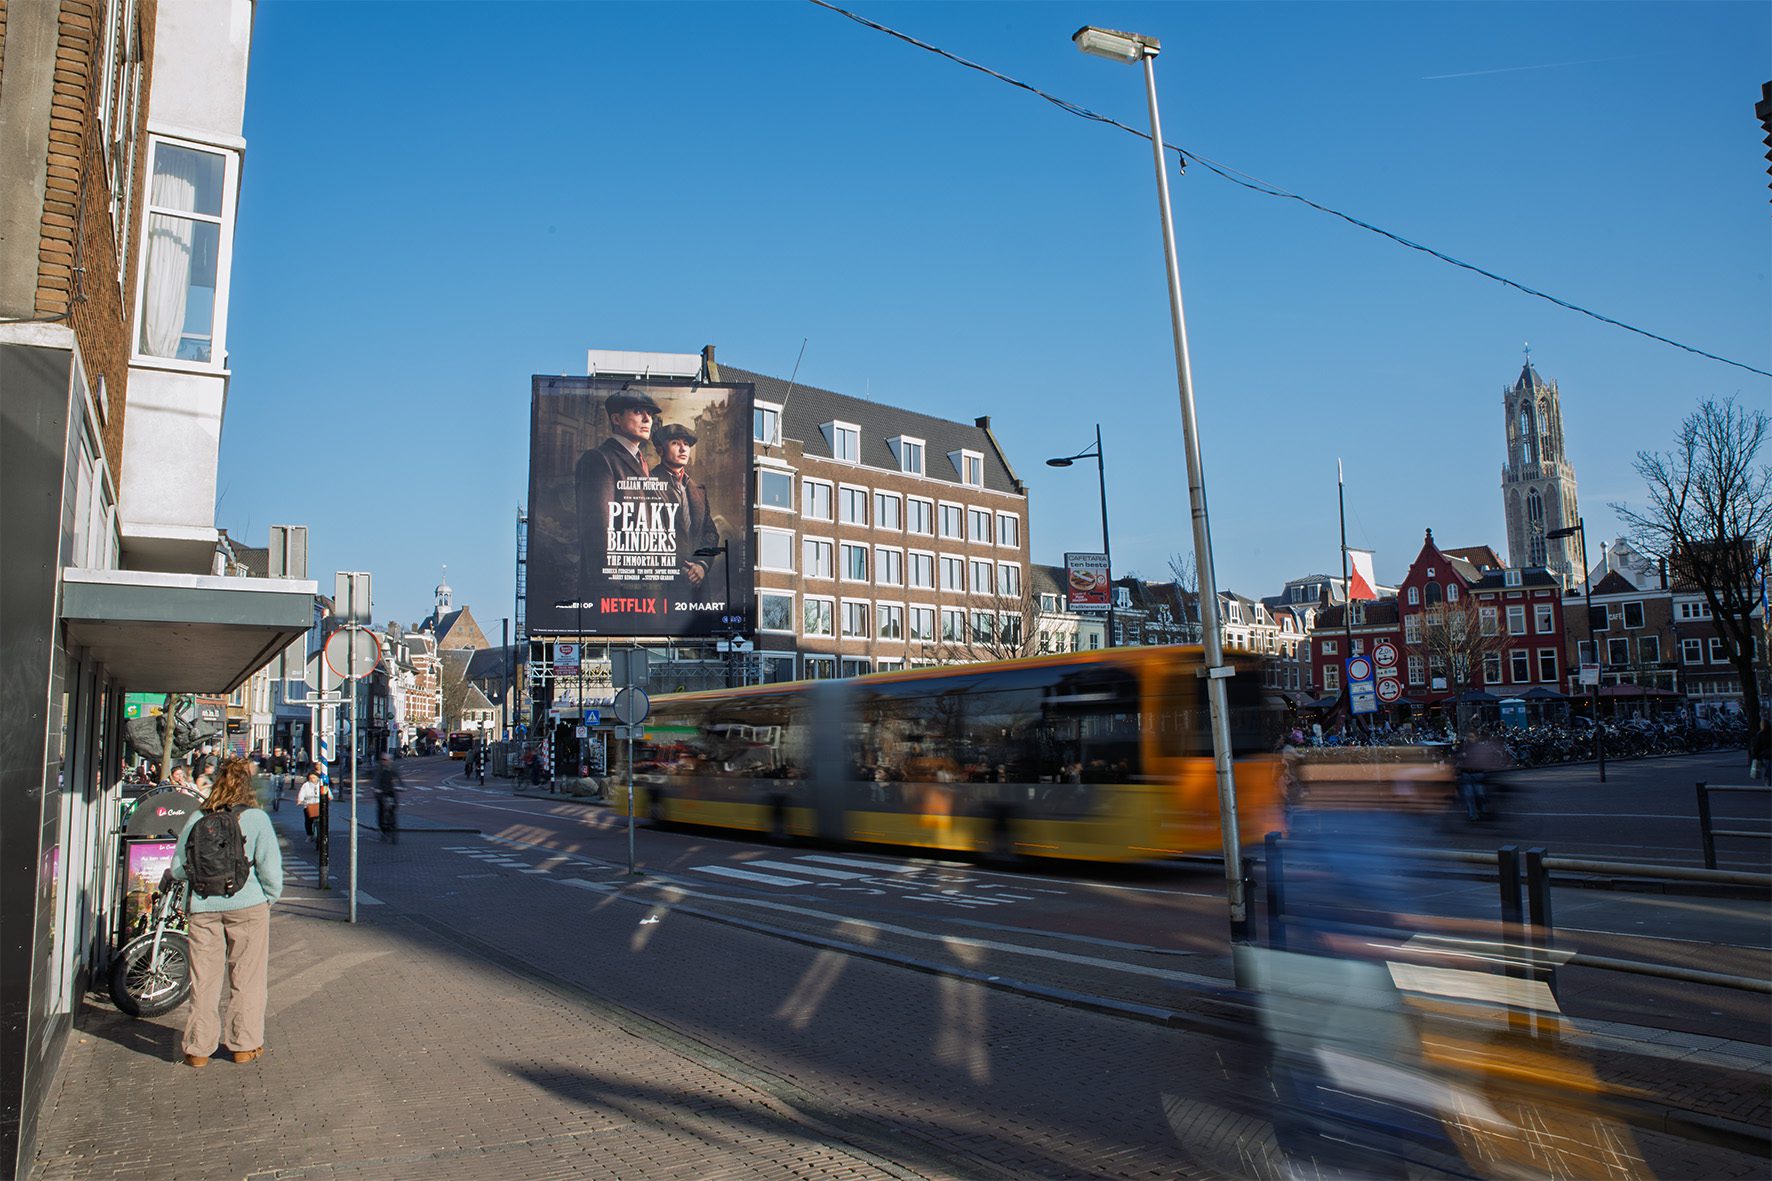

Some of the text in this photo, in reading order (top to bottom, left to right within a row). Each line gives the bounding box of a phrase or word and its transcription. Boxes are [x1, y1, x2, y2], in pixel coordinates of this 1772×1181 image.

[617, 481, 668, 491] CILLIAN MURPHY
[607, 501, 680, 532] PEAKY
[607, 531, 677, 552] BLINDERS
[607, 555, 676, 567] THE IMMORTAL MAN
[600, 597, 656, 614] NETFLIX
[674, 602, 687, 611] 20
[689, 602, 726, 611] MAART
[159, 808, 186, 817] La Costa
[129, 938, 167, 954] KENA
